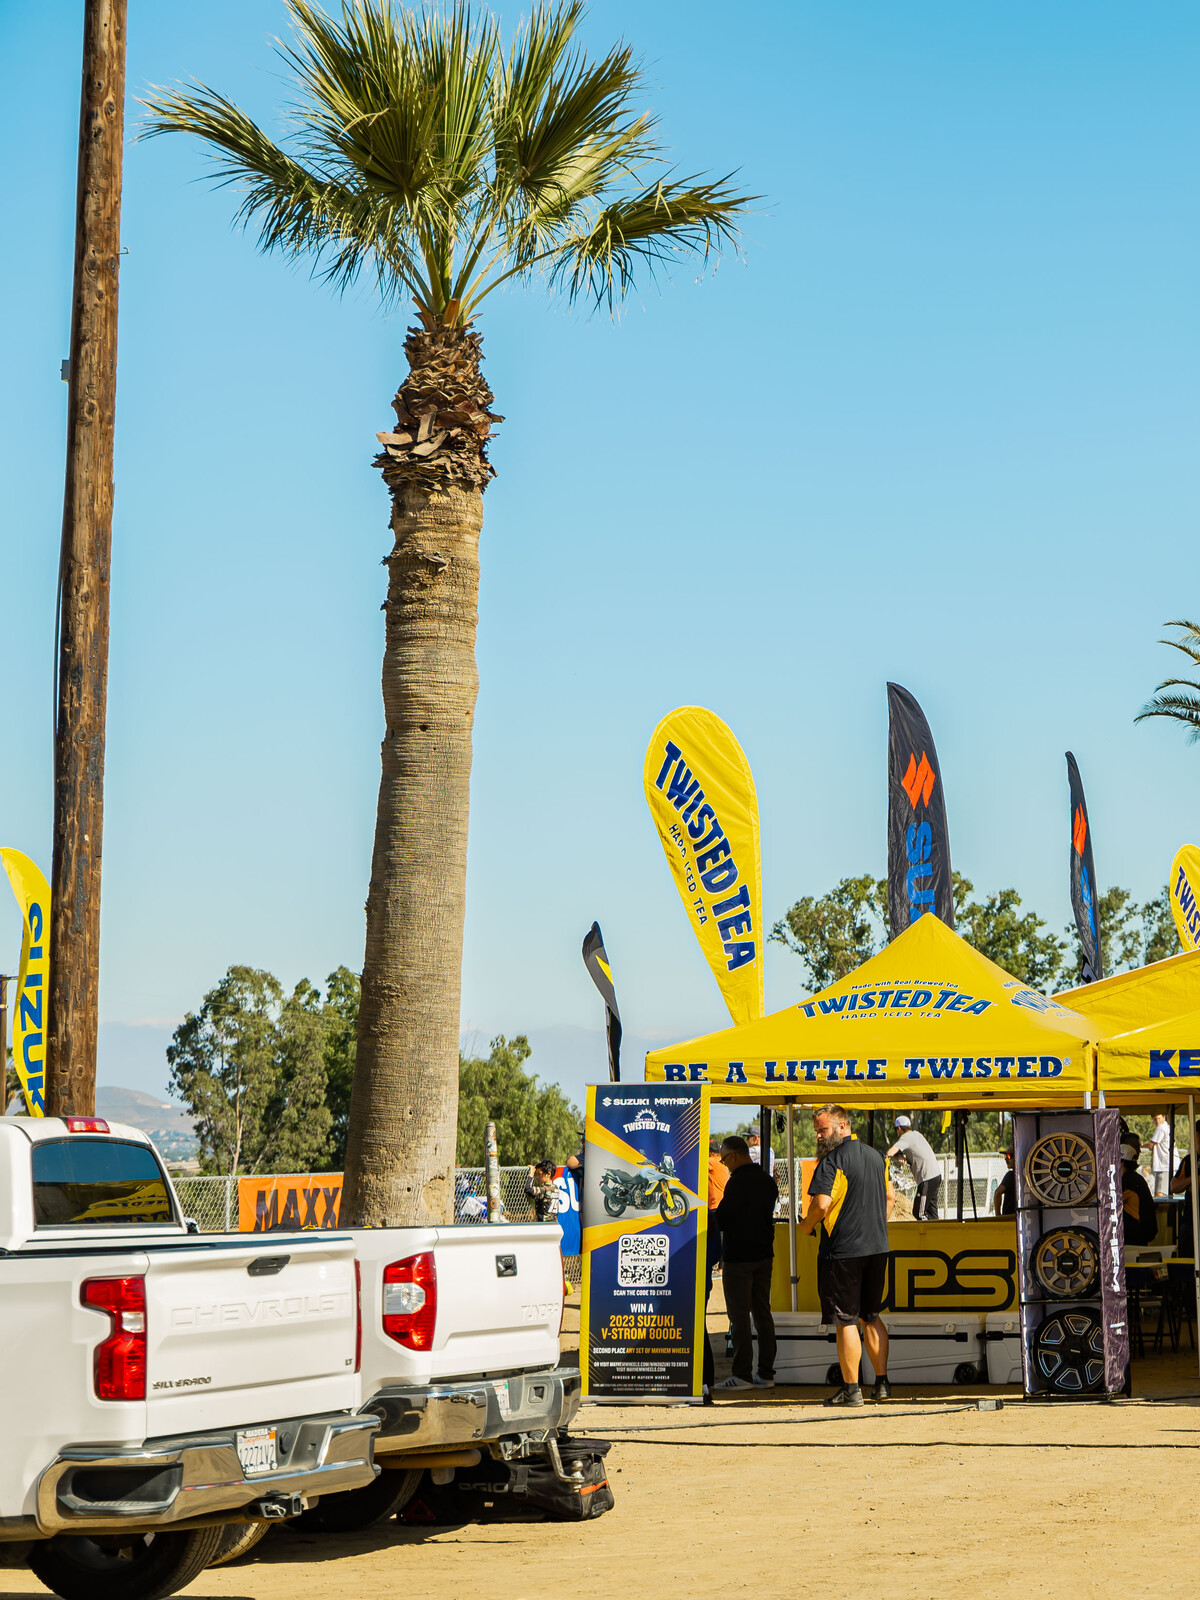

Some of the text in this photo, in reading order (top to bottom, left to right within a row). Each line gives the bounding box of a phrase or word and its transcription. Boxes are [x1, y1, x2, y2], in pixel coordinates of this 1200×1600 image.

[655, 740, 756, 972] TWISTED TEA
[669, 823, 708, 925] HARD ICED TEA
[914, 979, 944, 987] Brewed
[797, 989, 934, 1018] TWISTED
[932, 989, 993, 1016] TEA
[840, 1012, 877, 1020] HARD
[663, 1055, 1065, 1084] BE A LITTLE TWISTED
[613, 1097, 694, 1106] SUZUKI MAYHEM
[623, 1121, 671, 1134] TWISTED TEA
[613, 1289, 626, 1297] SCAN
[656, 1289, 672, 1297] ENTER
[171, 1292, 350, 1330] CHEVROLET
[630, 1303, 654, 1314] WIN A
[609, 1314, 675, 1328] 2023 SUZUKI
[601, 1327, 647, 1341] V-STROM
[593, 1347, 611, 1355] SECOND
[611, 1347, 626, 1355] PLACE
